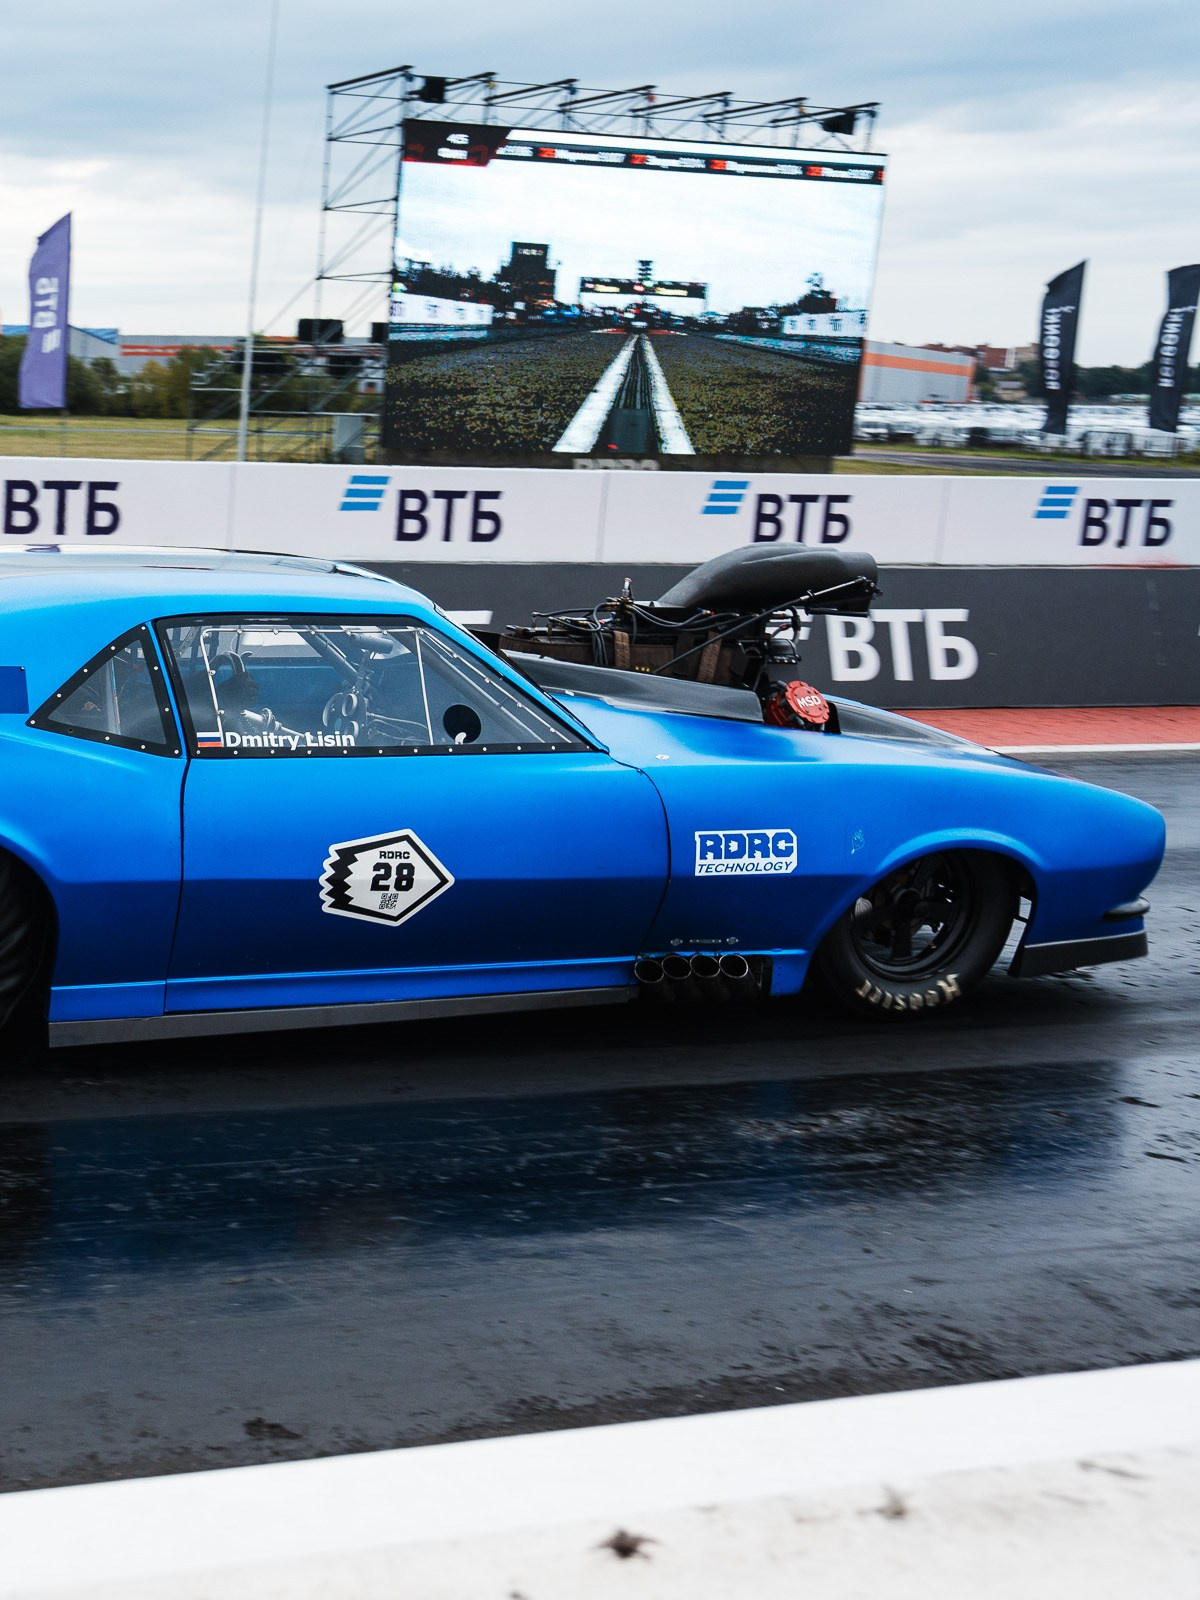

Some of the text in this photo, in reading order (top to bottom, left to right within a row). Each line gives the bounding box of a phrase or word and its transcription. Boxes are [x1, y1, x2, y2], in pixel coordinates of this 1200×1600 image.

[3, 480, 121, 536] ВТБ
[395, 490, 503, 542] ВТБ
[752, 494, 852, 544] ВТБ
[1078, 499, 1176, 547] ВТБ
[827, 608, 979, 682] ВТБ
[796, 695, 822, 708] MSD
[225, 731, 356, 751] Dmitry Lisin
[379, 850, 411, 860] RDRC
[698, 832, 794, 860] RDRC
[370, 862, 416, 892] 28
[698, 861, 793, 874] TECHNOLOGY
